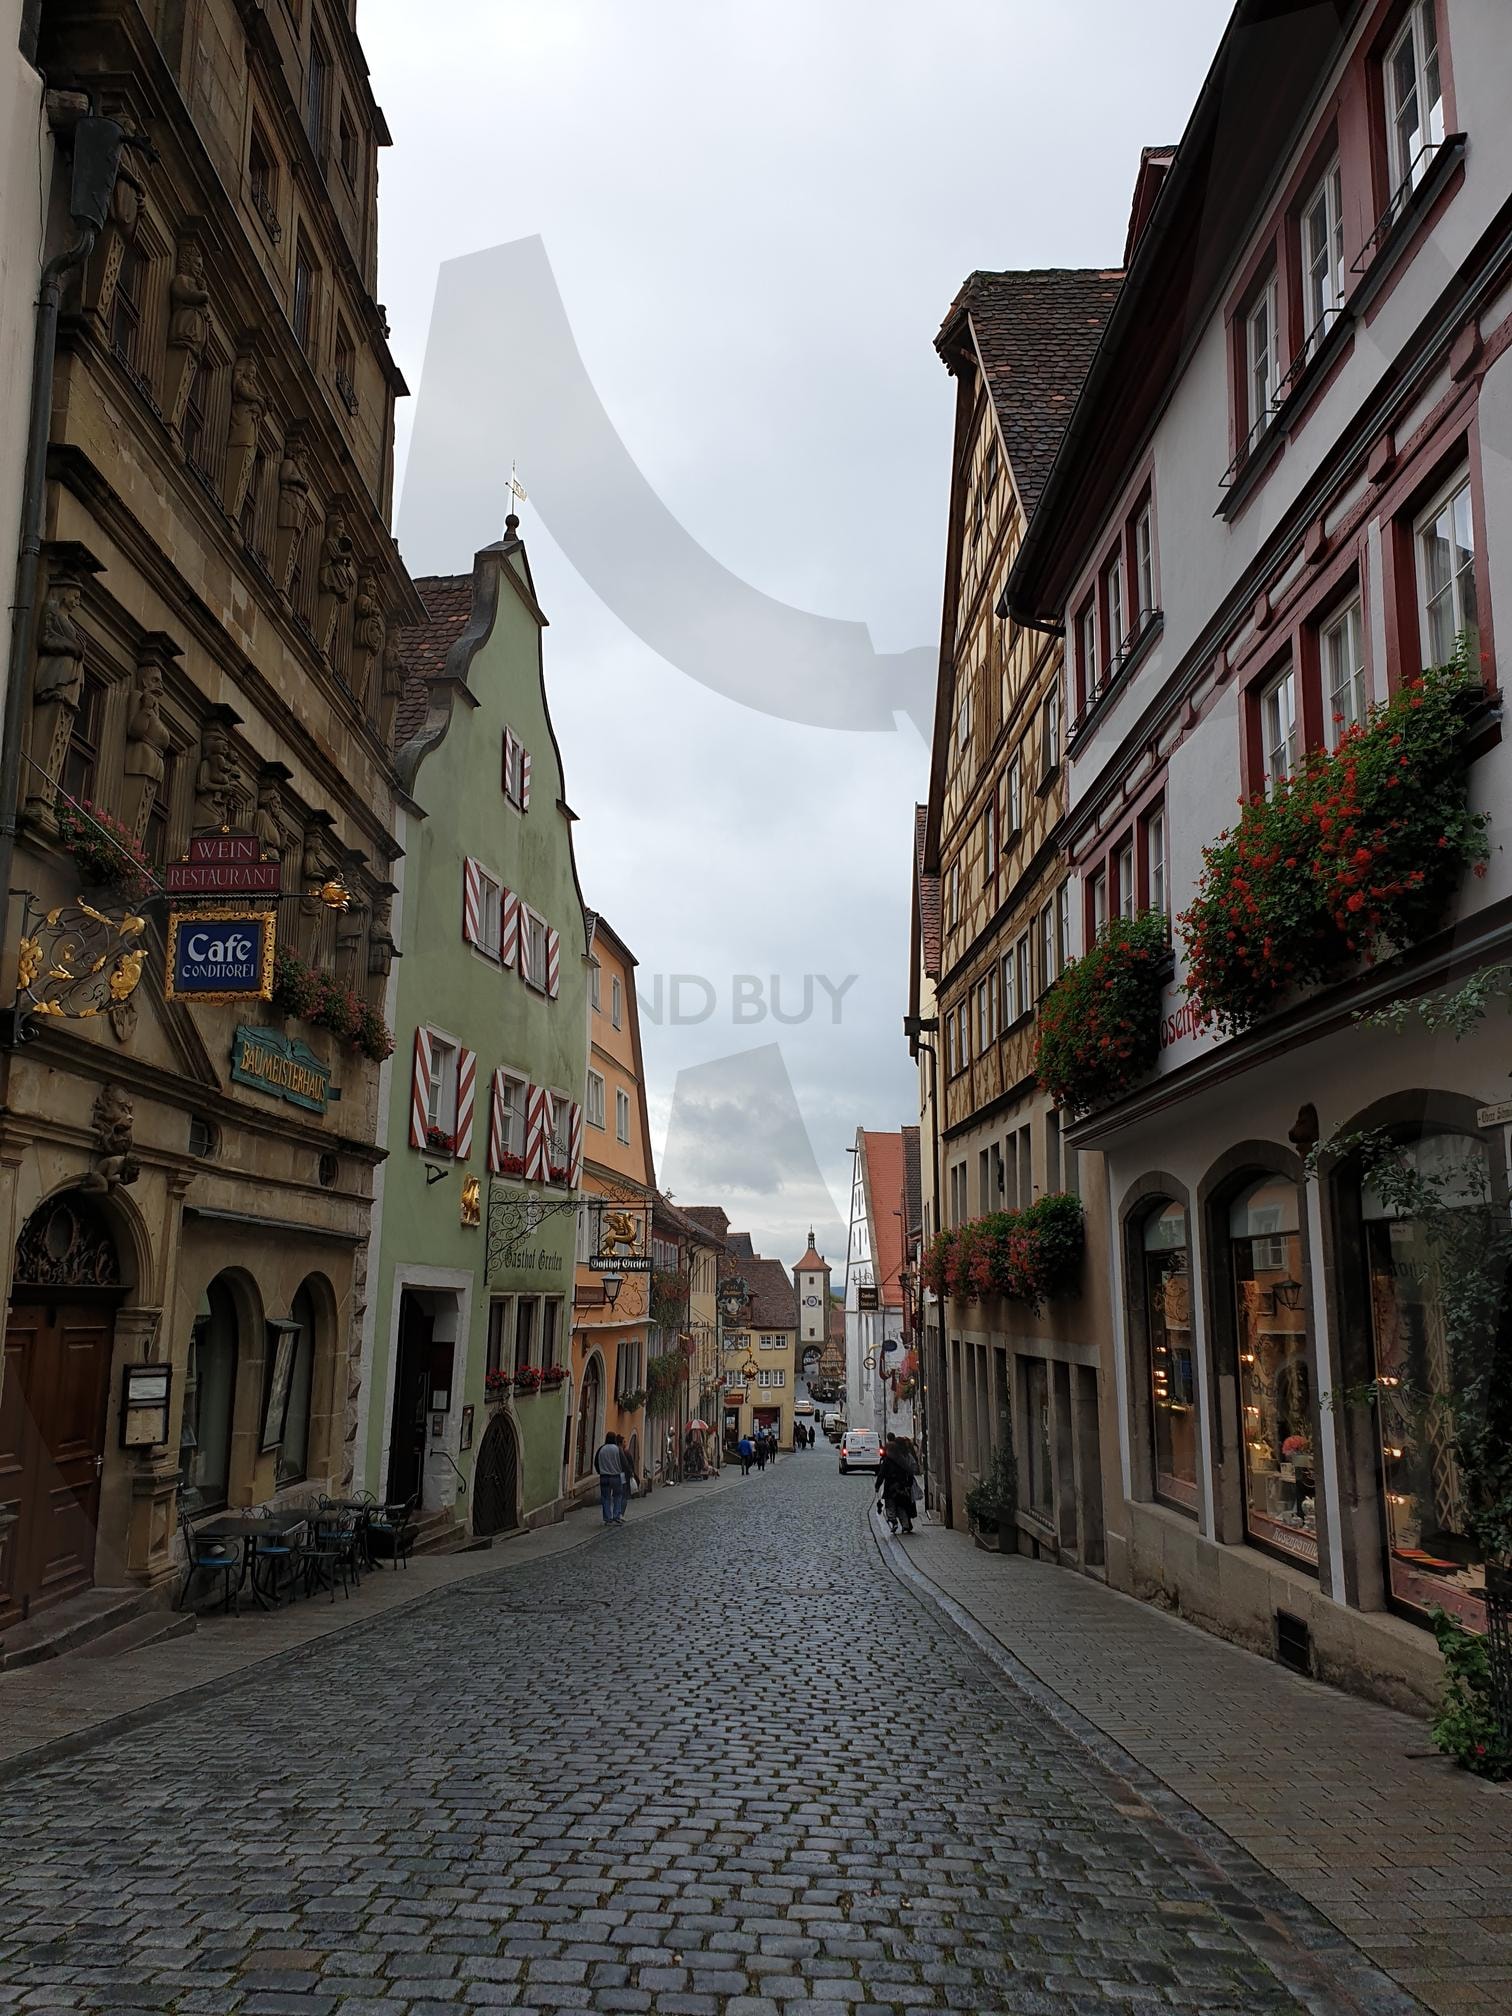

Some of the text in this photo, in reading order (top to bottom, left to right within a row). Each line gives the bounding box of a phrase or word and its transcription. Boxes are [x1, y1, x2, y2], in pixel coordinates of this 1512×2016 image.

[198, 841, 254, 858] WEIN
[170, 868, 279, 886] RESTAURANT
[188, 933, 252, 962] Cafe
[182, 964, 254, 978] CONDITOREI
[240, 1040, 326, 1101] BAUMEISTERHAUS
